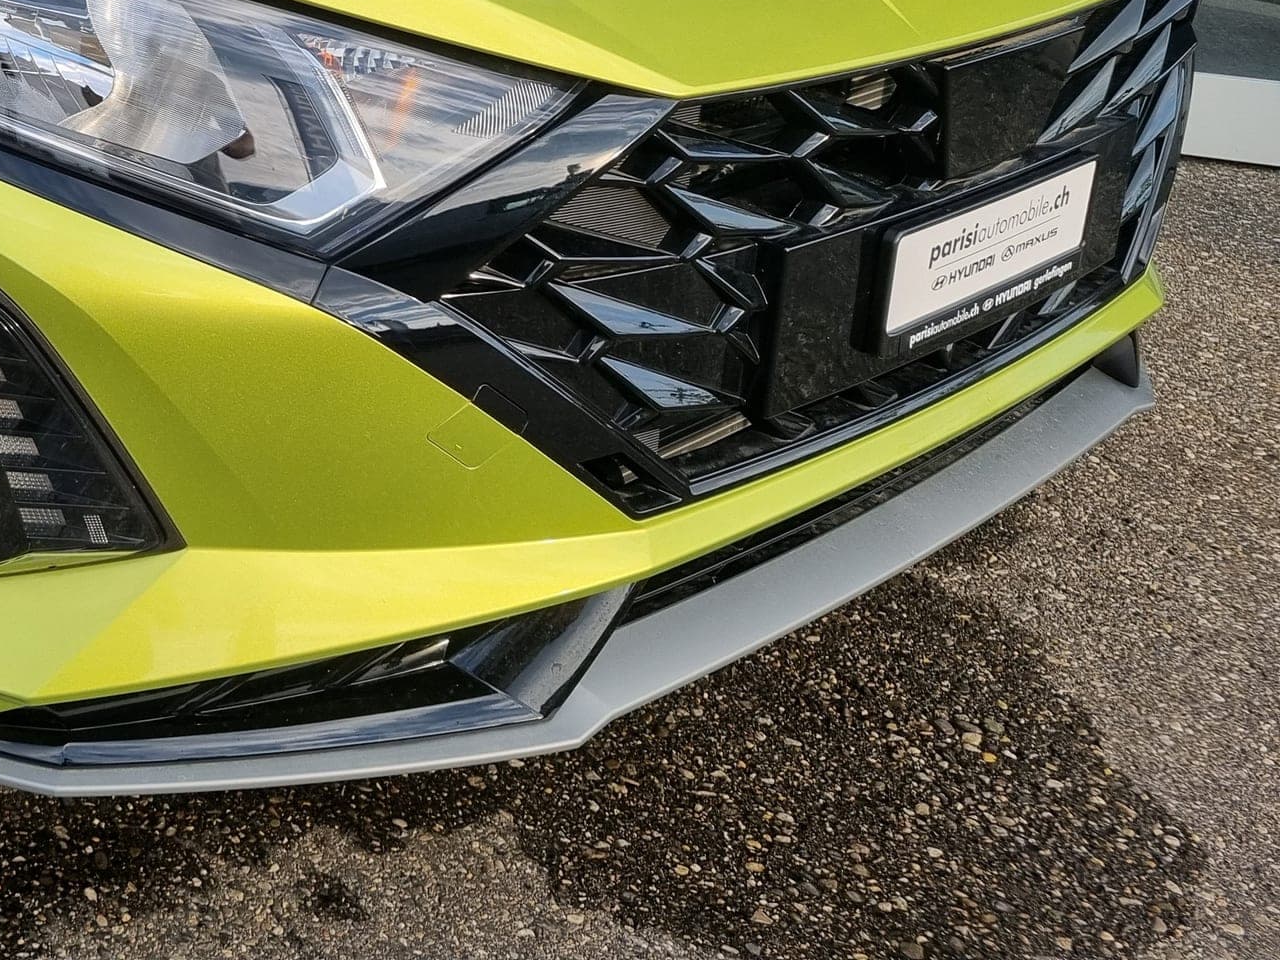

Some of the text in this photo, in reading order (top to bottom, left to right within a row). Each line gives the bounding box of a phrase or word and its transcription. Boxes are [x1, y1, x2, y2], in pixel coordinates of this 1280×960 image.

[928, 185, 1071, 270] parisiautomobile.ch
[948, 226, 1059, 285] HYUNDAI MAXUS
[909, 302, 980, 349] parisiautomobile.ch
[995, 278, 1032, 307] HYUNDAI
